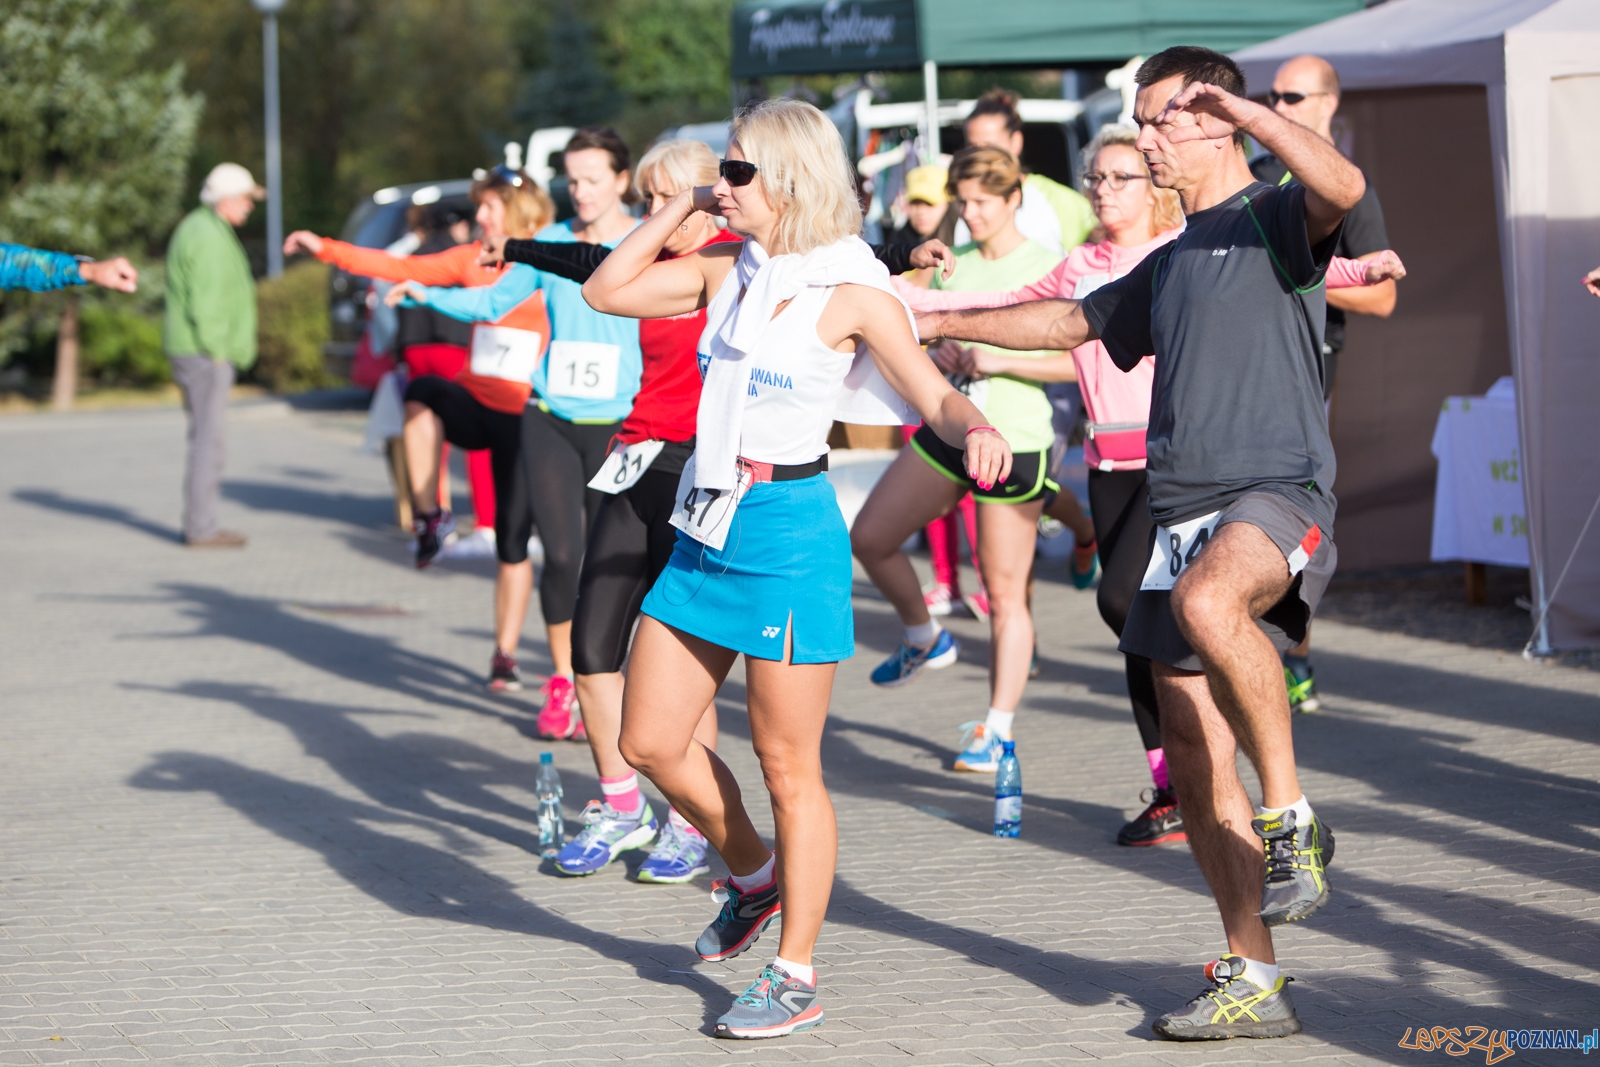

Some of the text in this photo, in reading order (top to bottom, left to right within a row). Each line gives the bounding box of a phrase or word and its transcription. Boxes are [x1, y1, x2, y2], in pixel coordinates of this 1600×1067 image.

[496, 344, 511, 367] 7
[565, 360, 600, 388] 15
[613, 453, 643, 485] 81
[683, 487, 722, 528] 47
[1169, 528, 1209, 577] 84
